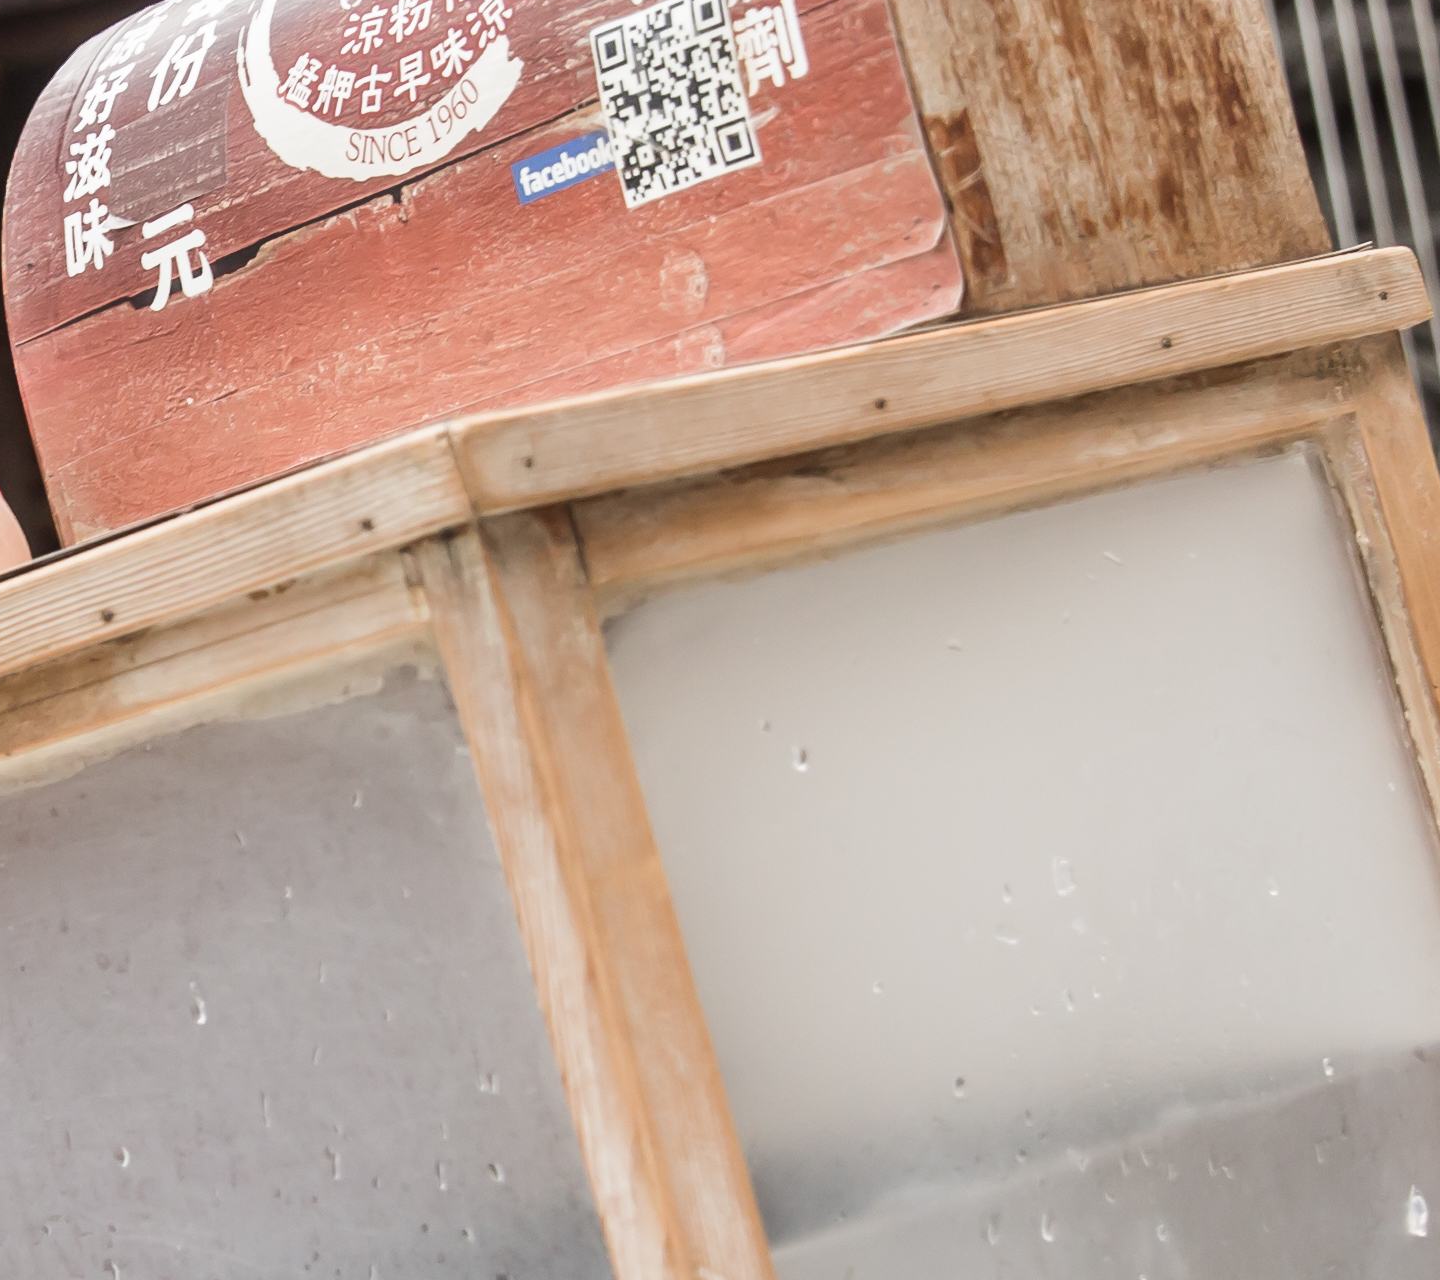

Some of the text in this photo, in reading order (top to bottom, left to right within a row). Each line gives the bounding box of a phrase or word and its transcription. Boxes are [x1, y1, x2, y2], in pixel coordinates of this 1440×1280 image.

[345, 78, 480, 166] SINCE 1960
[518, 134, 616, 197] facebook
[140, 202, 215, 313] 元
